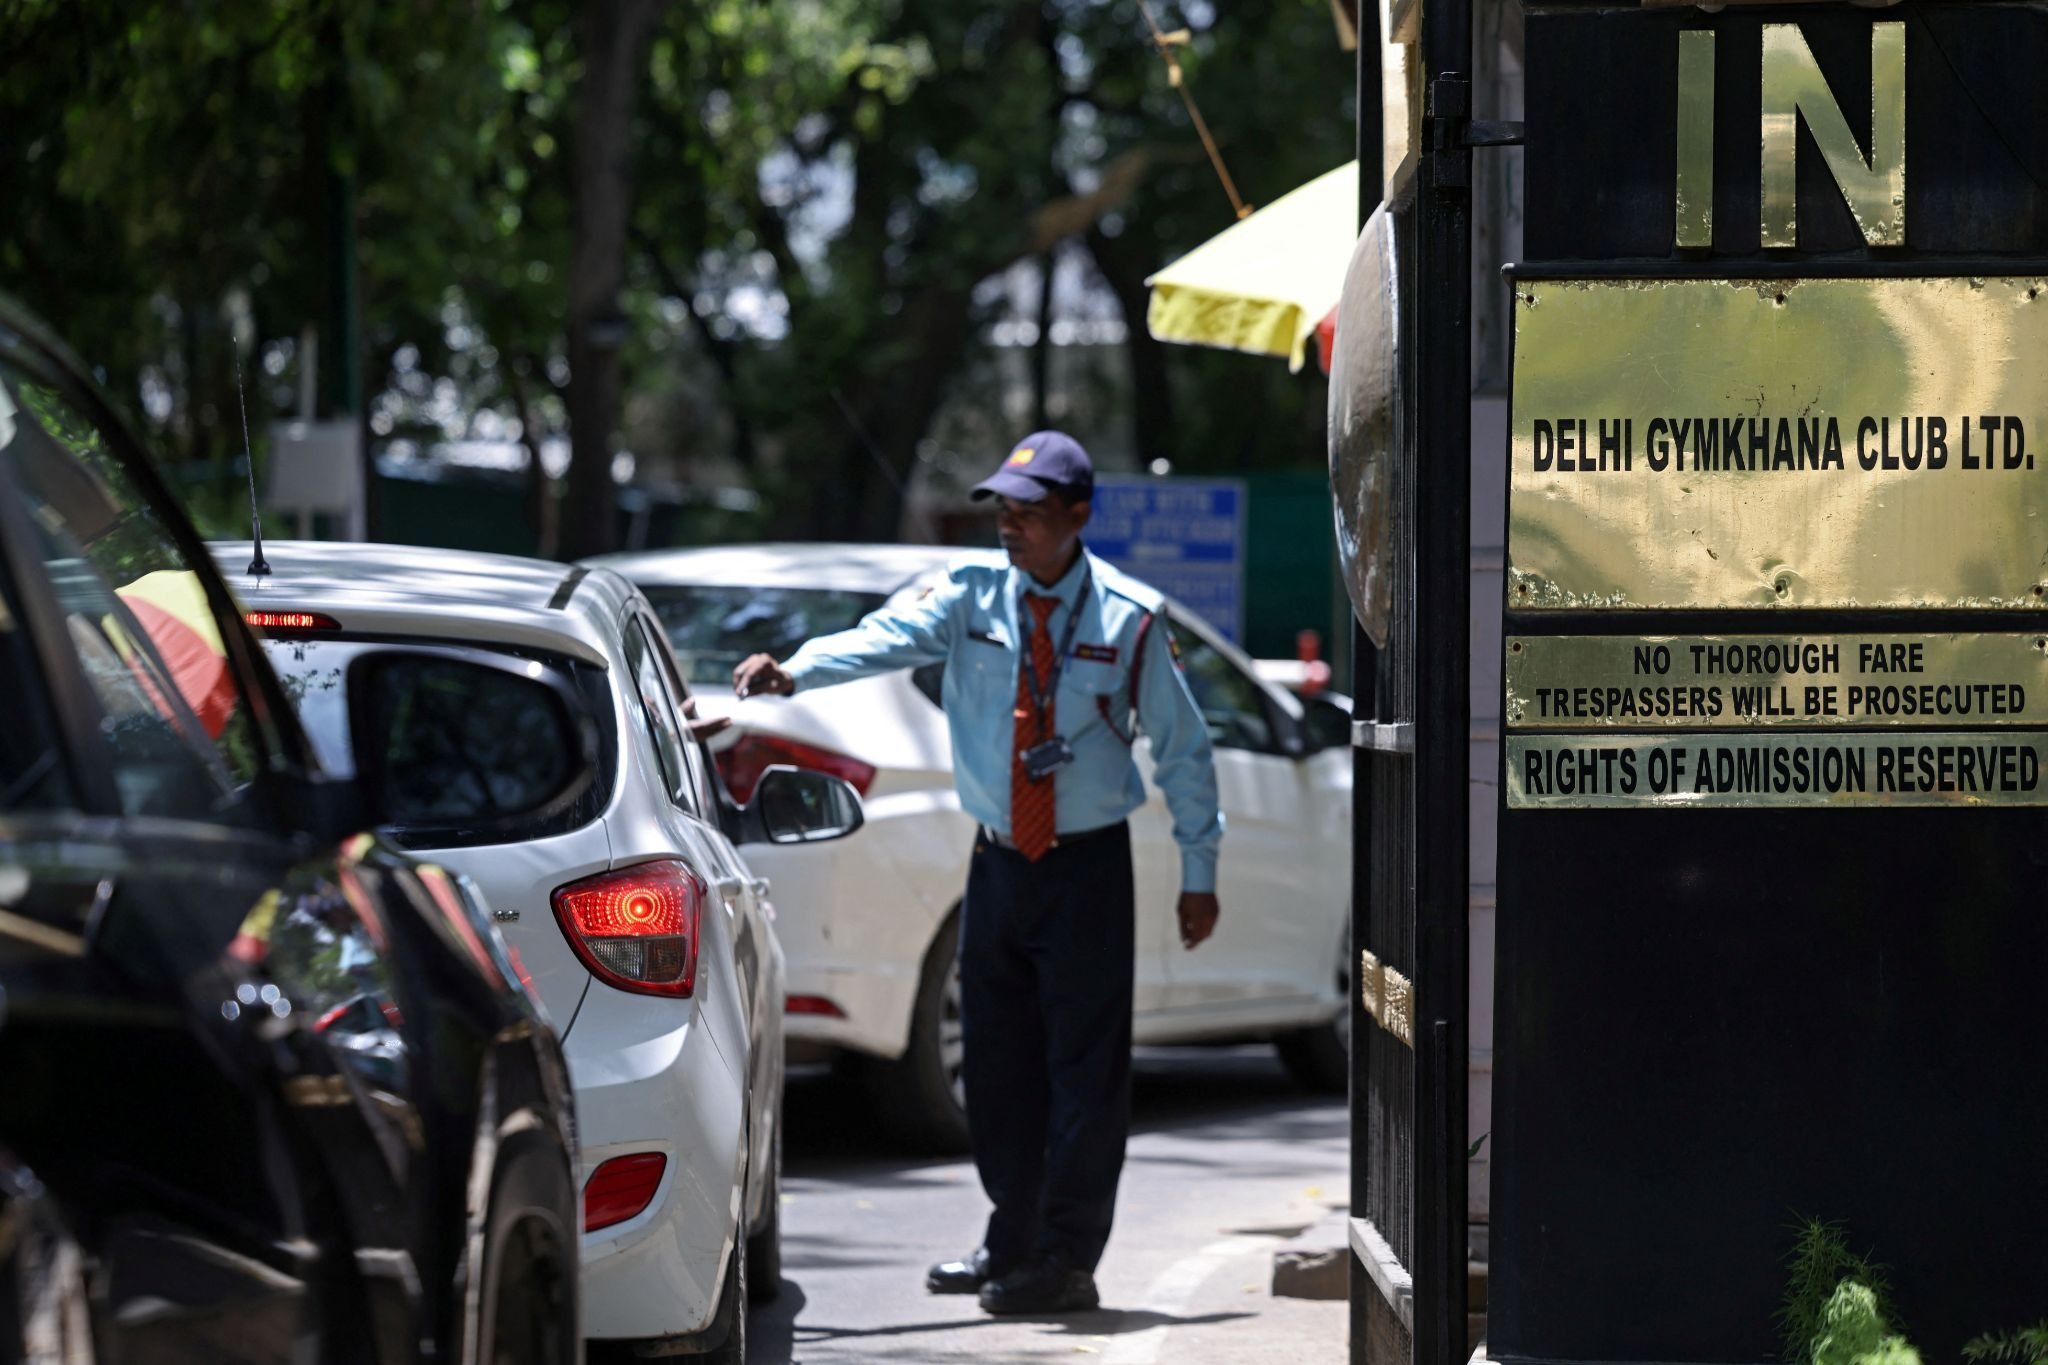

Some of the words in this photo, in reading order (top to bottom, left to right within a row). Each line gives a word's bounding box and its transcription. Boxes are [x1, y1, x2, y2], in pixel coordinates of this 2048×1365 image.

[1676, 21, 1905, 247] IN
[1533, 418, 1632, 472] DELHI
[1646, 416, 1845, 472] GYMKHANA
[1856, 416, 1948, 471] CLUB
[1961, 415, 2034, 470] LTD.
[1633, 645, 1671, 675] NO
[1689, 643, 1839, 675] THOROUGH
[1859, 643, 1924, 674] FARE
[1535, 686, 1723, 718] TRESPASSERS
[1731, 686, 1795, 717] WILL
[1804, 685, 1838, 716] BE
[1848, 683, 2026, 716] PROSECUTED
[1524, 747, 1638, 795] RIGHTS
[1647, 747, 1687, 795] OF
[1693, 746, 1866, 794] ADMISSION
[1876, 745, 2039, 793] RESERVED
